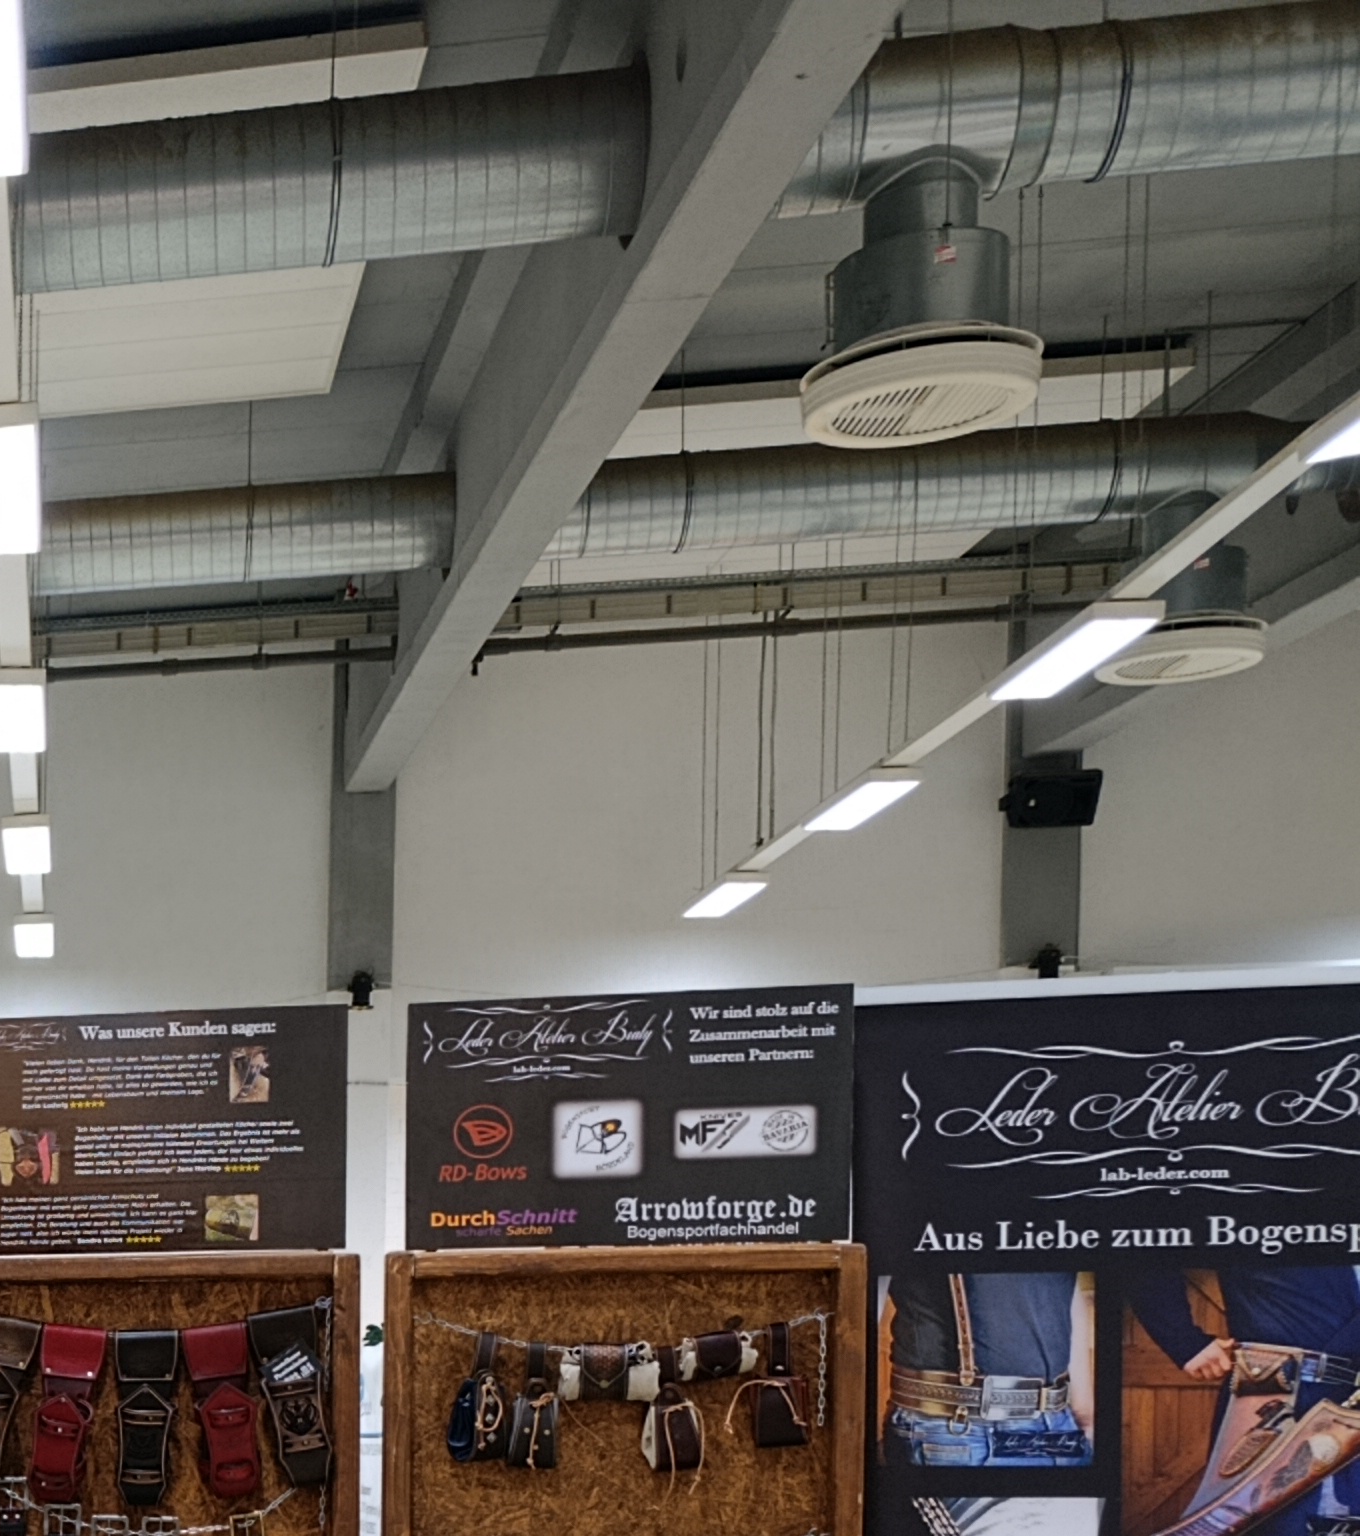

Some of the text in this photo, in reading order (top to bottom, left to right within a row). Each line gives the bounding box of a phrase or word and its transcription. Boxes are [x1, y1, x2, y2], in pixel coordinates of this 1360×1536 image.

[690, 1001, 840, 1020] Wir sind stolz auf die
[78, 1025, 114, 1041] Was
[116, 1026, 165, 1040] unsere
[167, 1020, 229, 1037] Kunden
[232, 1022, 277, 1037] sagen:
[439, 1010, 657, 1057] Leder Atelier Bialy
[689, 1024, 836, 1043] Zusammenarbeit mit
[689, 1047, 815, 1064] unseren Partnern:
[935, 1067, 1058, 1146] Leder
[1069, 1063, 1245, 1139] Atelier
[762, 1121, 809, 1141] BAVARIA
[438, 1163, 528, 1183] RD-Bows
[1100, 1165, 1230, 1182] lab-leder.com
[430, 1208, 578, 1228] DurchSchnitt
[614, 1194, 817, 1223] Arrowforge.de
[505, 1225, 553, 1237] Sachen
[627, 1221, 800, 1240] Bogensportfachhandel
[914, 1222, 984, 1252] Aus
[995, 1219, 1100, 1251] Liebe
[1111, 1225, 1193, 1248] zum
